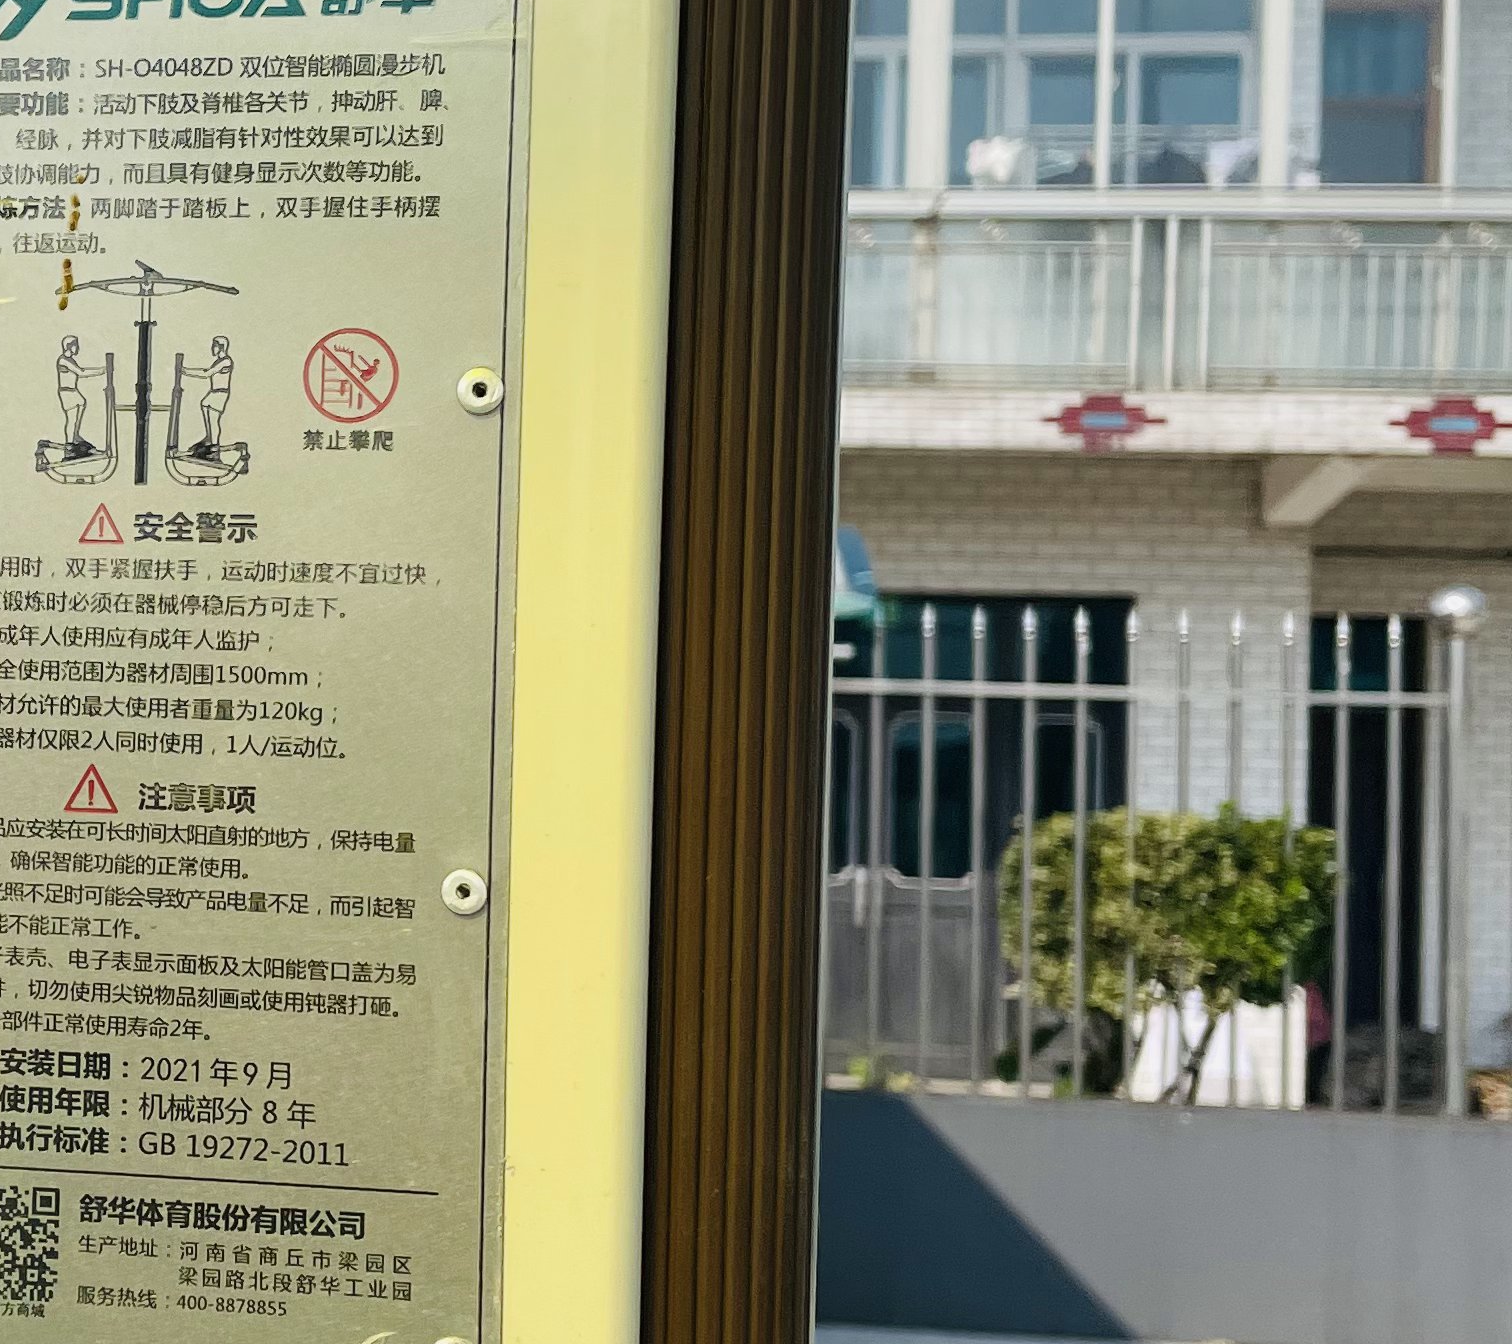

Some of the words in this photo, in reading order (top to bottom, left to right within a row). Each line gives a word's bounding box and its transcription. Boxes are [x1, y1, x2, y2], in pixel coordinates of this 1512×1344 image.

[303, 429, 393, 452] 禁止攀爬
[133, 511, 258, 544] 安全警示
[138, 782, 256, 814] 注意事项
[79, 1194, 366, 1240] 舒华体育股份有限公司
[178, 1266, 412, 1301] 梁园路北段舒华工业园
